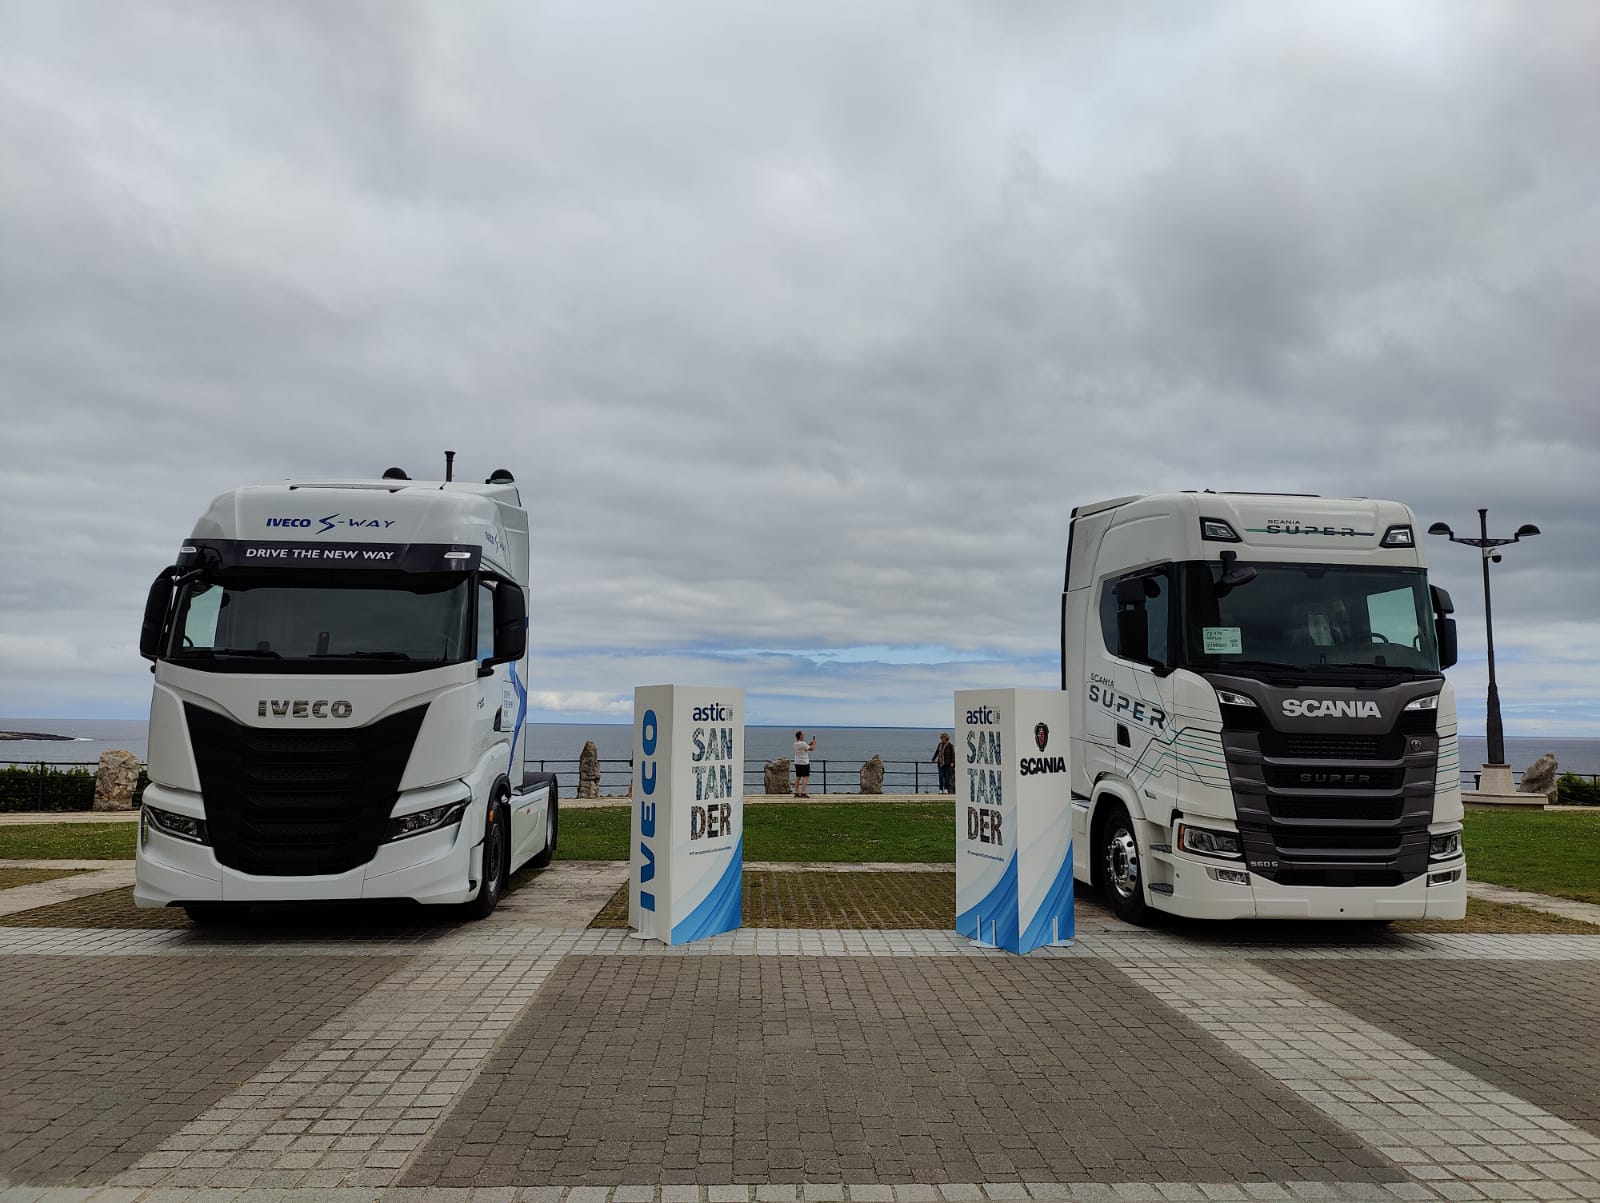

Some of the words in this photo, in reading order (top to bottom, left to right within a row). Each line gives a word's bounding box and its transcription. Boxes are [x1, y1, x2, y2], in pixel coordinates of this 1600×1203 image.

[266, 518, 311, 528] IVECO
[1266, 525, 1355, 537] SUPER
[246, 548, 289, 558] DRIVE
[292, 549, 320, 559] THE
[323, 550, 358, 560] NEW
[363, 551, 395, 560] WAY
[1090, 672, 1115, 688] SCANIA
[257, 699, 353, 719] IVECO
[692, 702, 726, 722] astic
[966, 705, 993, 725] astic
[1088, 684, 1166, 730] SUPER
[1281, 699, 1383, 719] SCANIA
[692, 727, 733, 762] SAN
[966, 730, 1002, 766] SAN
[1020, 756, 1067, 776] SCANIA
[691, 764, 733, 801] TAN
[967, 768, 1003, 806] TAN
[1299, 772, 1371, 784] SUPER
[640, 709, 658, 913] IVECO
[690, 802, 732, 841] DER
[967, 806, 1004, 846] DER
